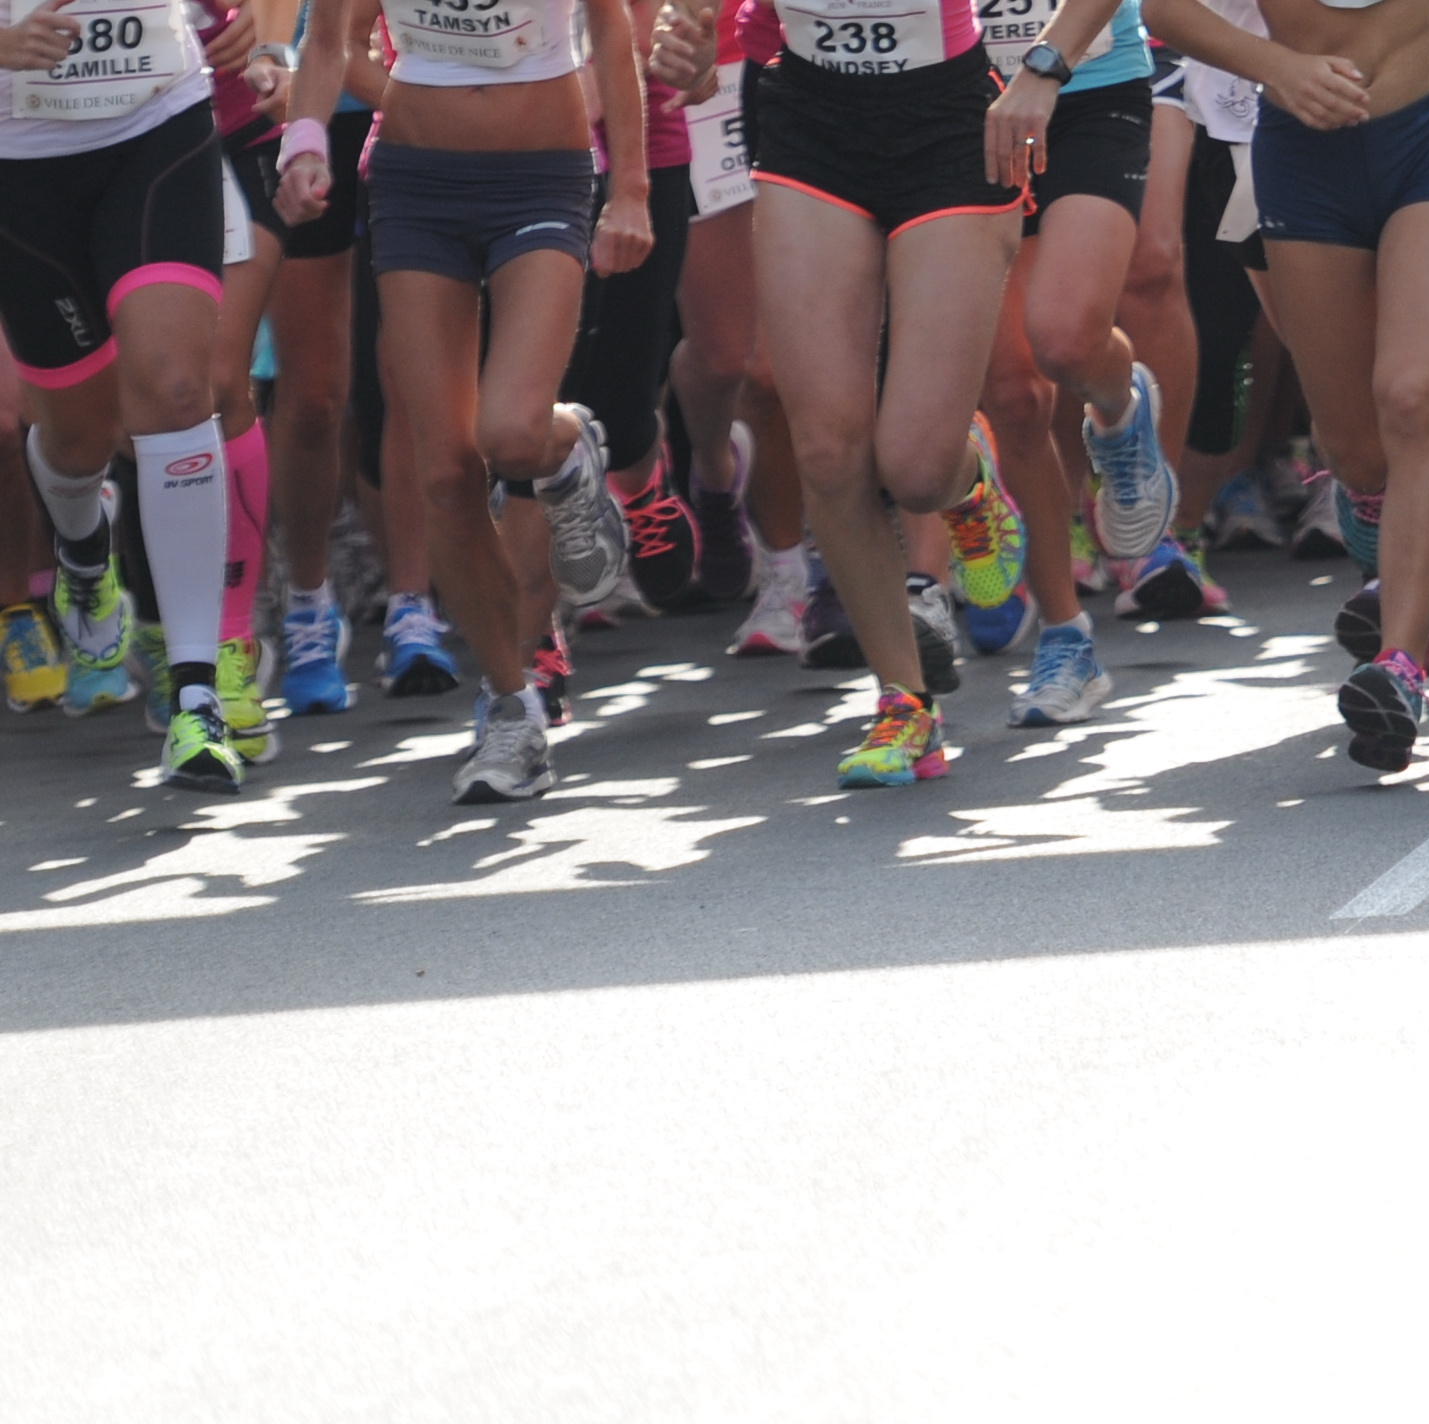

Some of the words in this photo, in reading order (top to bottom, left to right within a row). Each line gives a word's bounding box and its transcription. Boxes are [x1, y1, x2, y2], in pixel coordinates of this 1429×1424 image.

[414, 9, 511, 33] TAMSYN
[814, 20, 898, 54] 238
[414, 40, 444, 53] VILLE
[449, 45, 464, 55] DE
[469, 48, 500, 59] NICE
[49, 55, 152, 80] CAMILLE
[44, 97, 80, 110] VILLE
[83, 95, 101, 108] DE
[103, 93, 136, 107] NICE
[55, 298, 91, 347] 2XU
